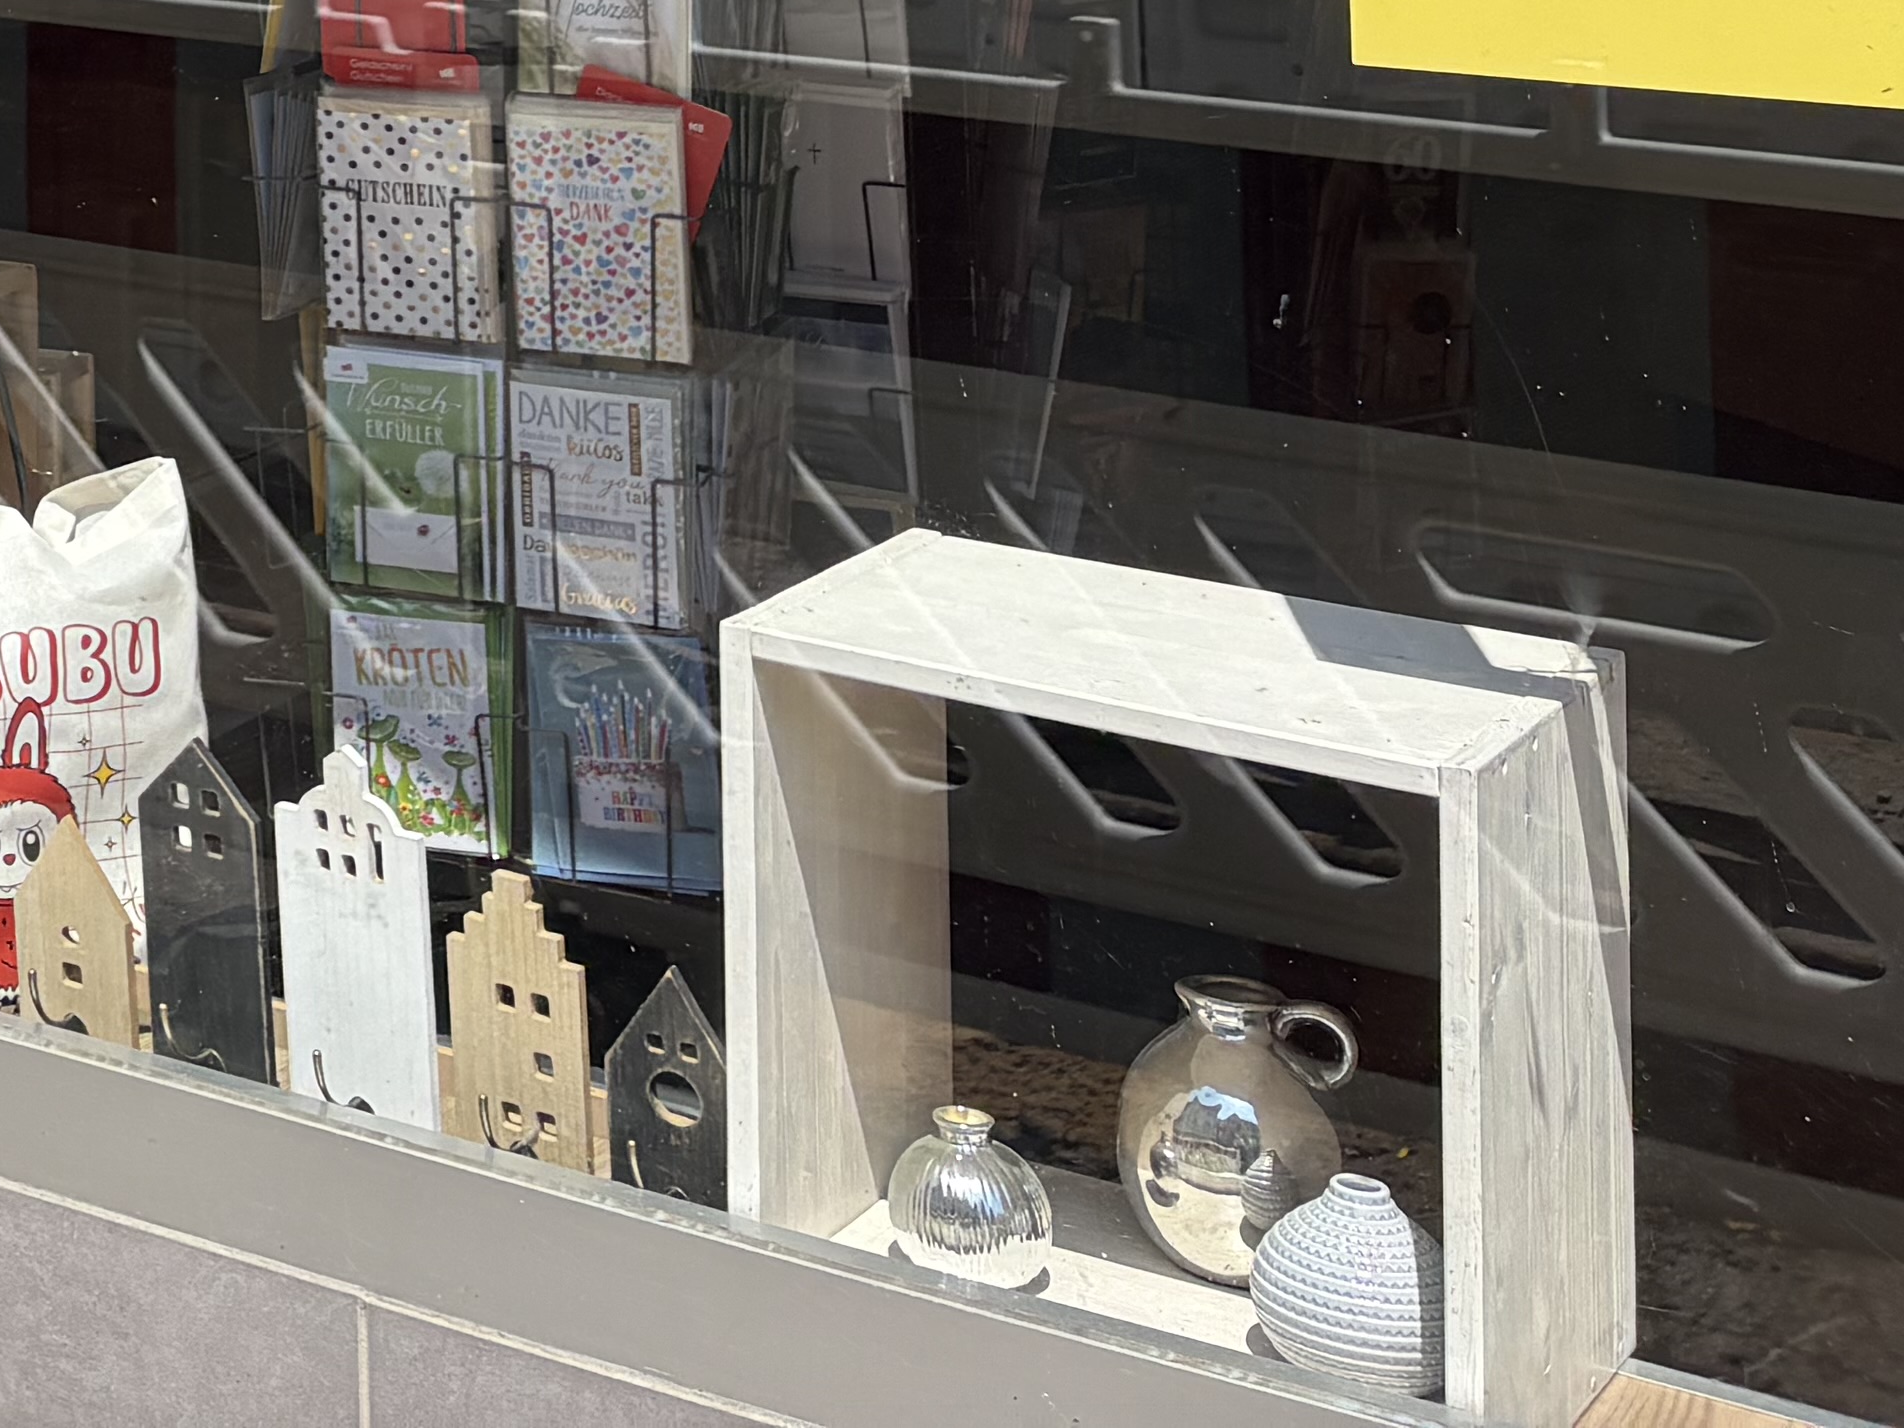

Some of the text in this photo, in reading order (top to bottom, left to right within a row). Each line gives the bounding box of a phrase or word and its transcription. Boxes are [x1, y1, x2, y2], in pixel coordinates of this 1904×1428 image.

[345, 178, 449, 210] GUTSCHEIN
[569, 201, 613, 224] DANK
[518, 390, 624, 437] DANKE
[365, 417, 445, 446] ERFÜLLER
